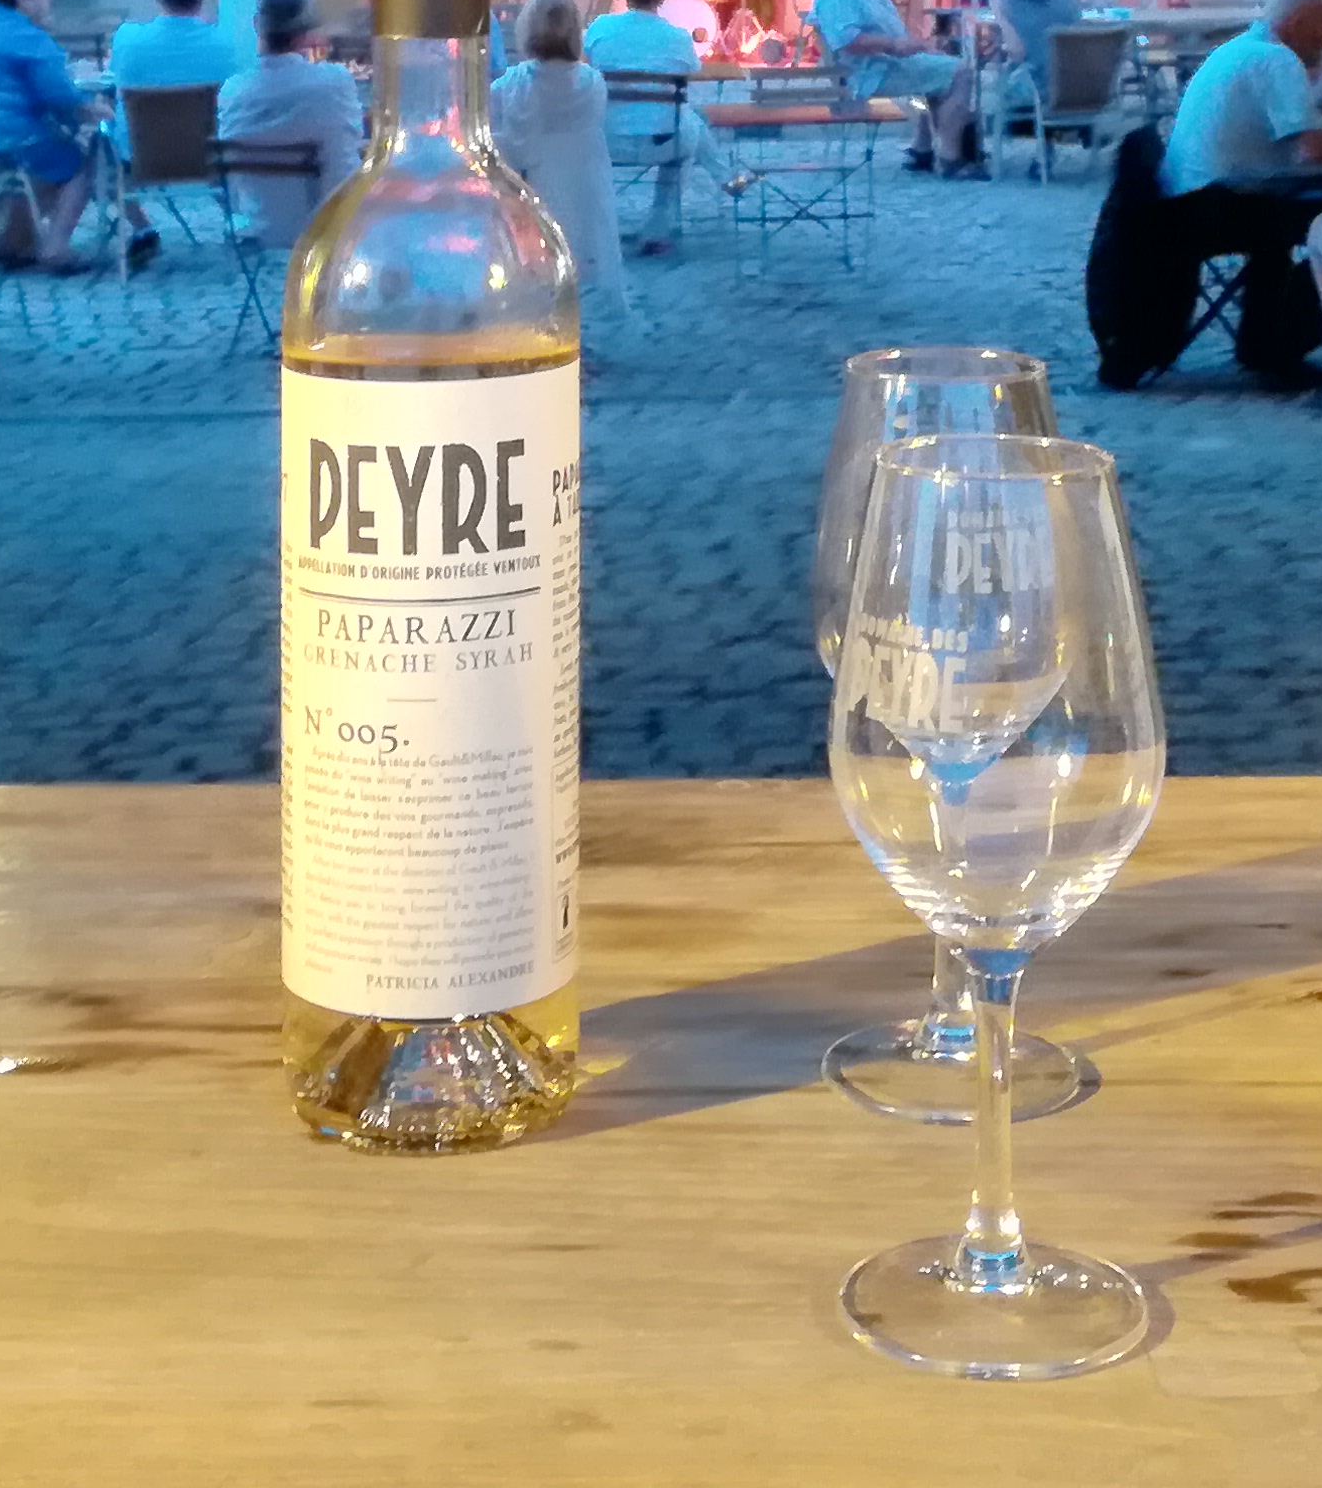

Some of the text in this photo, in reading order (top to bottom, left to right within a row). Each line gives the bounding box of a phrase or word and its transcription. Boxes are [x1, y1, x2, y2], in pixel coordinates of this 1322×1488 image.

[310, 438, 526, 556] PEYRE
[298, 554, 541, 581] APPELLATION D'ORIGINE PROTÉGÉE VENTOUX
[317, 608, 516, 645] PAPARAZZI
[304, 642, 534, 673] GRENACHE SYRAH
[366, 962, 535, 992] PATRICIA ALEXANDRE
